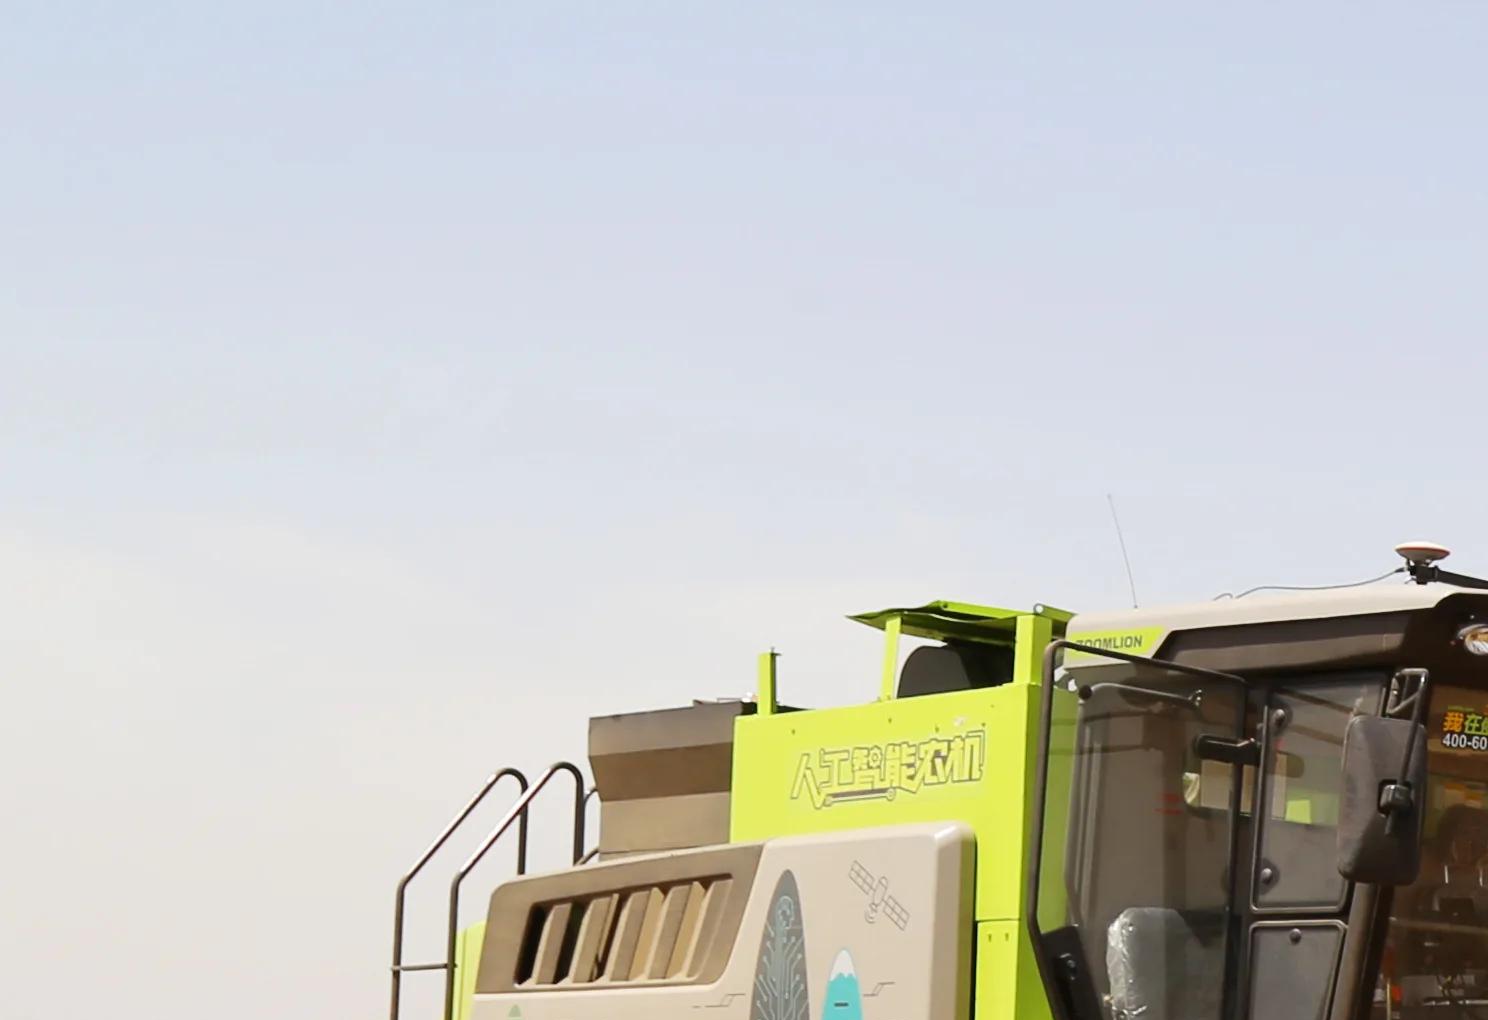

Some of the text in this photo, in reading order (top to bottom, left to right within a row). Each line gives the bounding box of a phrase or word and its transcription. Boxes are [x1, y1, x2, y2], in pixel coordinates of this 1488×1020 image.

[791, 730, 985, 809] 人工智能农机
